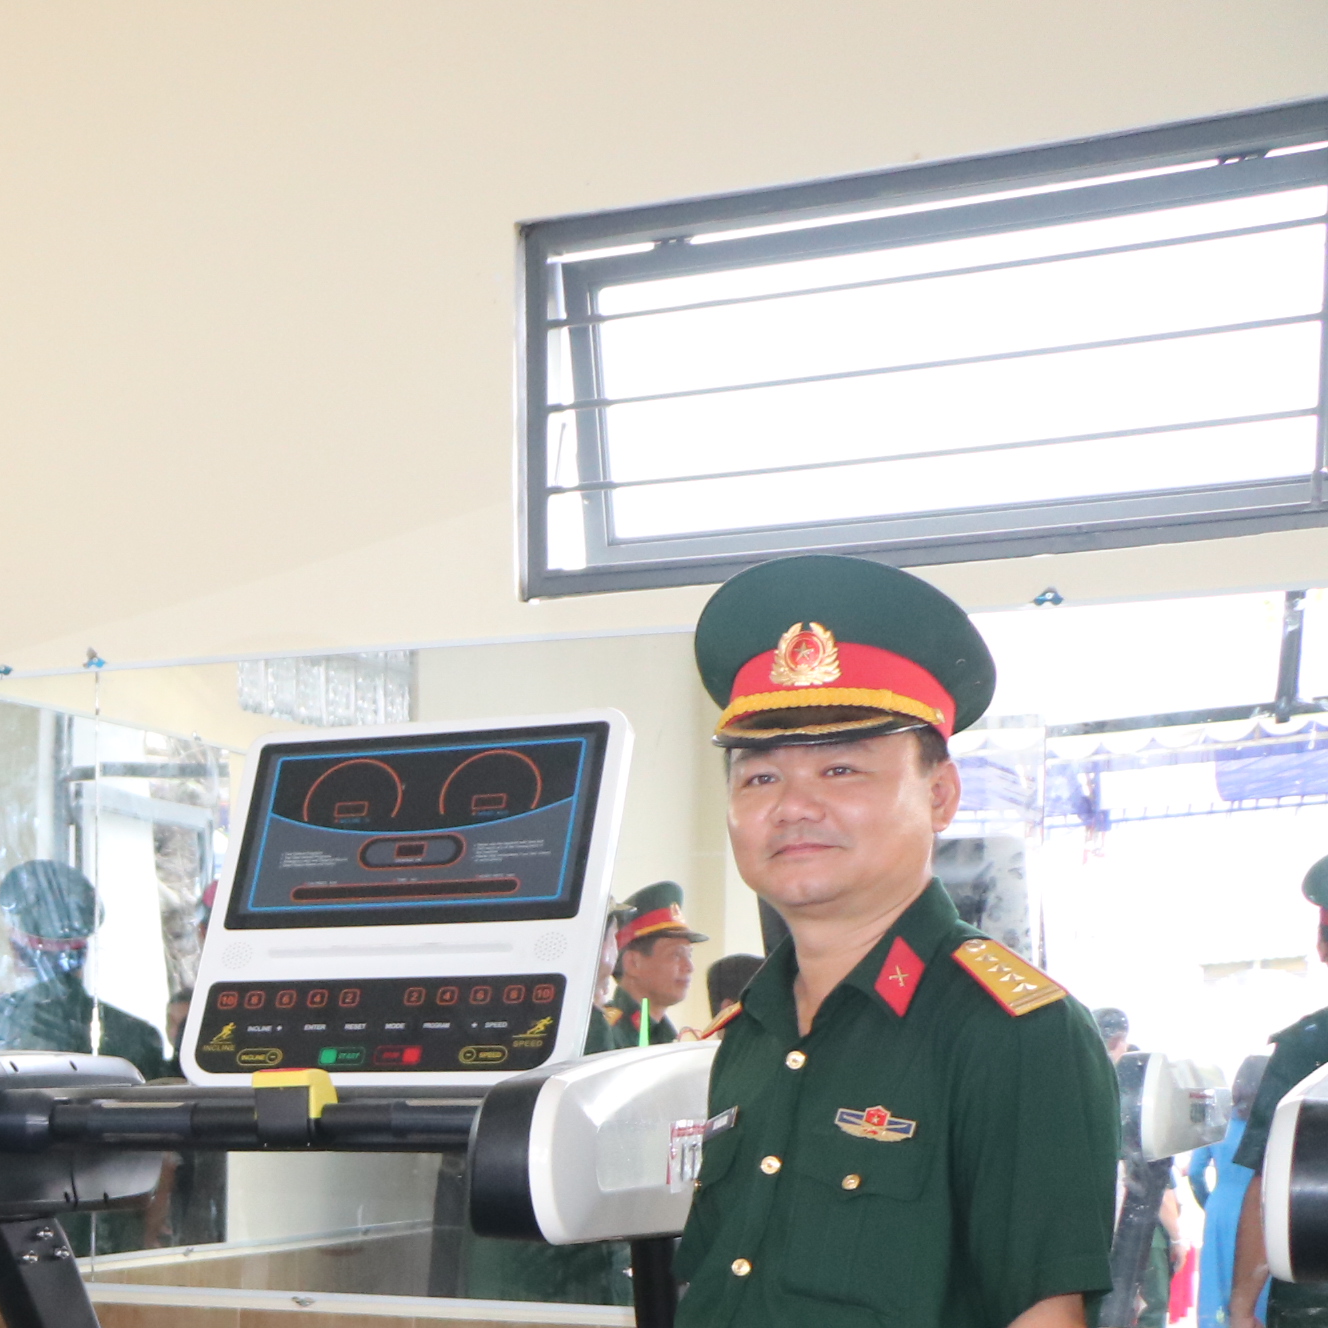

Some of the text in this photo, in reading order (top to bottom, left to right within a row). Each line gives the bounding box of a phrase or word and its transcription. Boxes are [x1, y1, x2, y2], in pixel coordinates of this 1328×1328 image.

[303, 1023, 327, 1031] ENTER
[343, 1022, 367, 1031] RESET
[384, 1022, 406, 1030] MODE
[422, 1021, 451, 1029] PROGRAM
[484, 1021, 509, 1029] SPEED
[202, 1043, 236, 1052] INCLINE
[512, 1039, 544, 1048] SPEED
[336, 1051, 361, 1061] START
